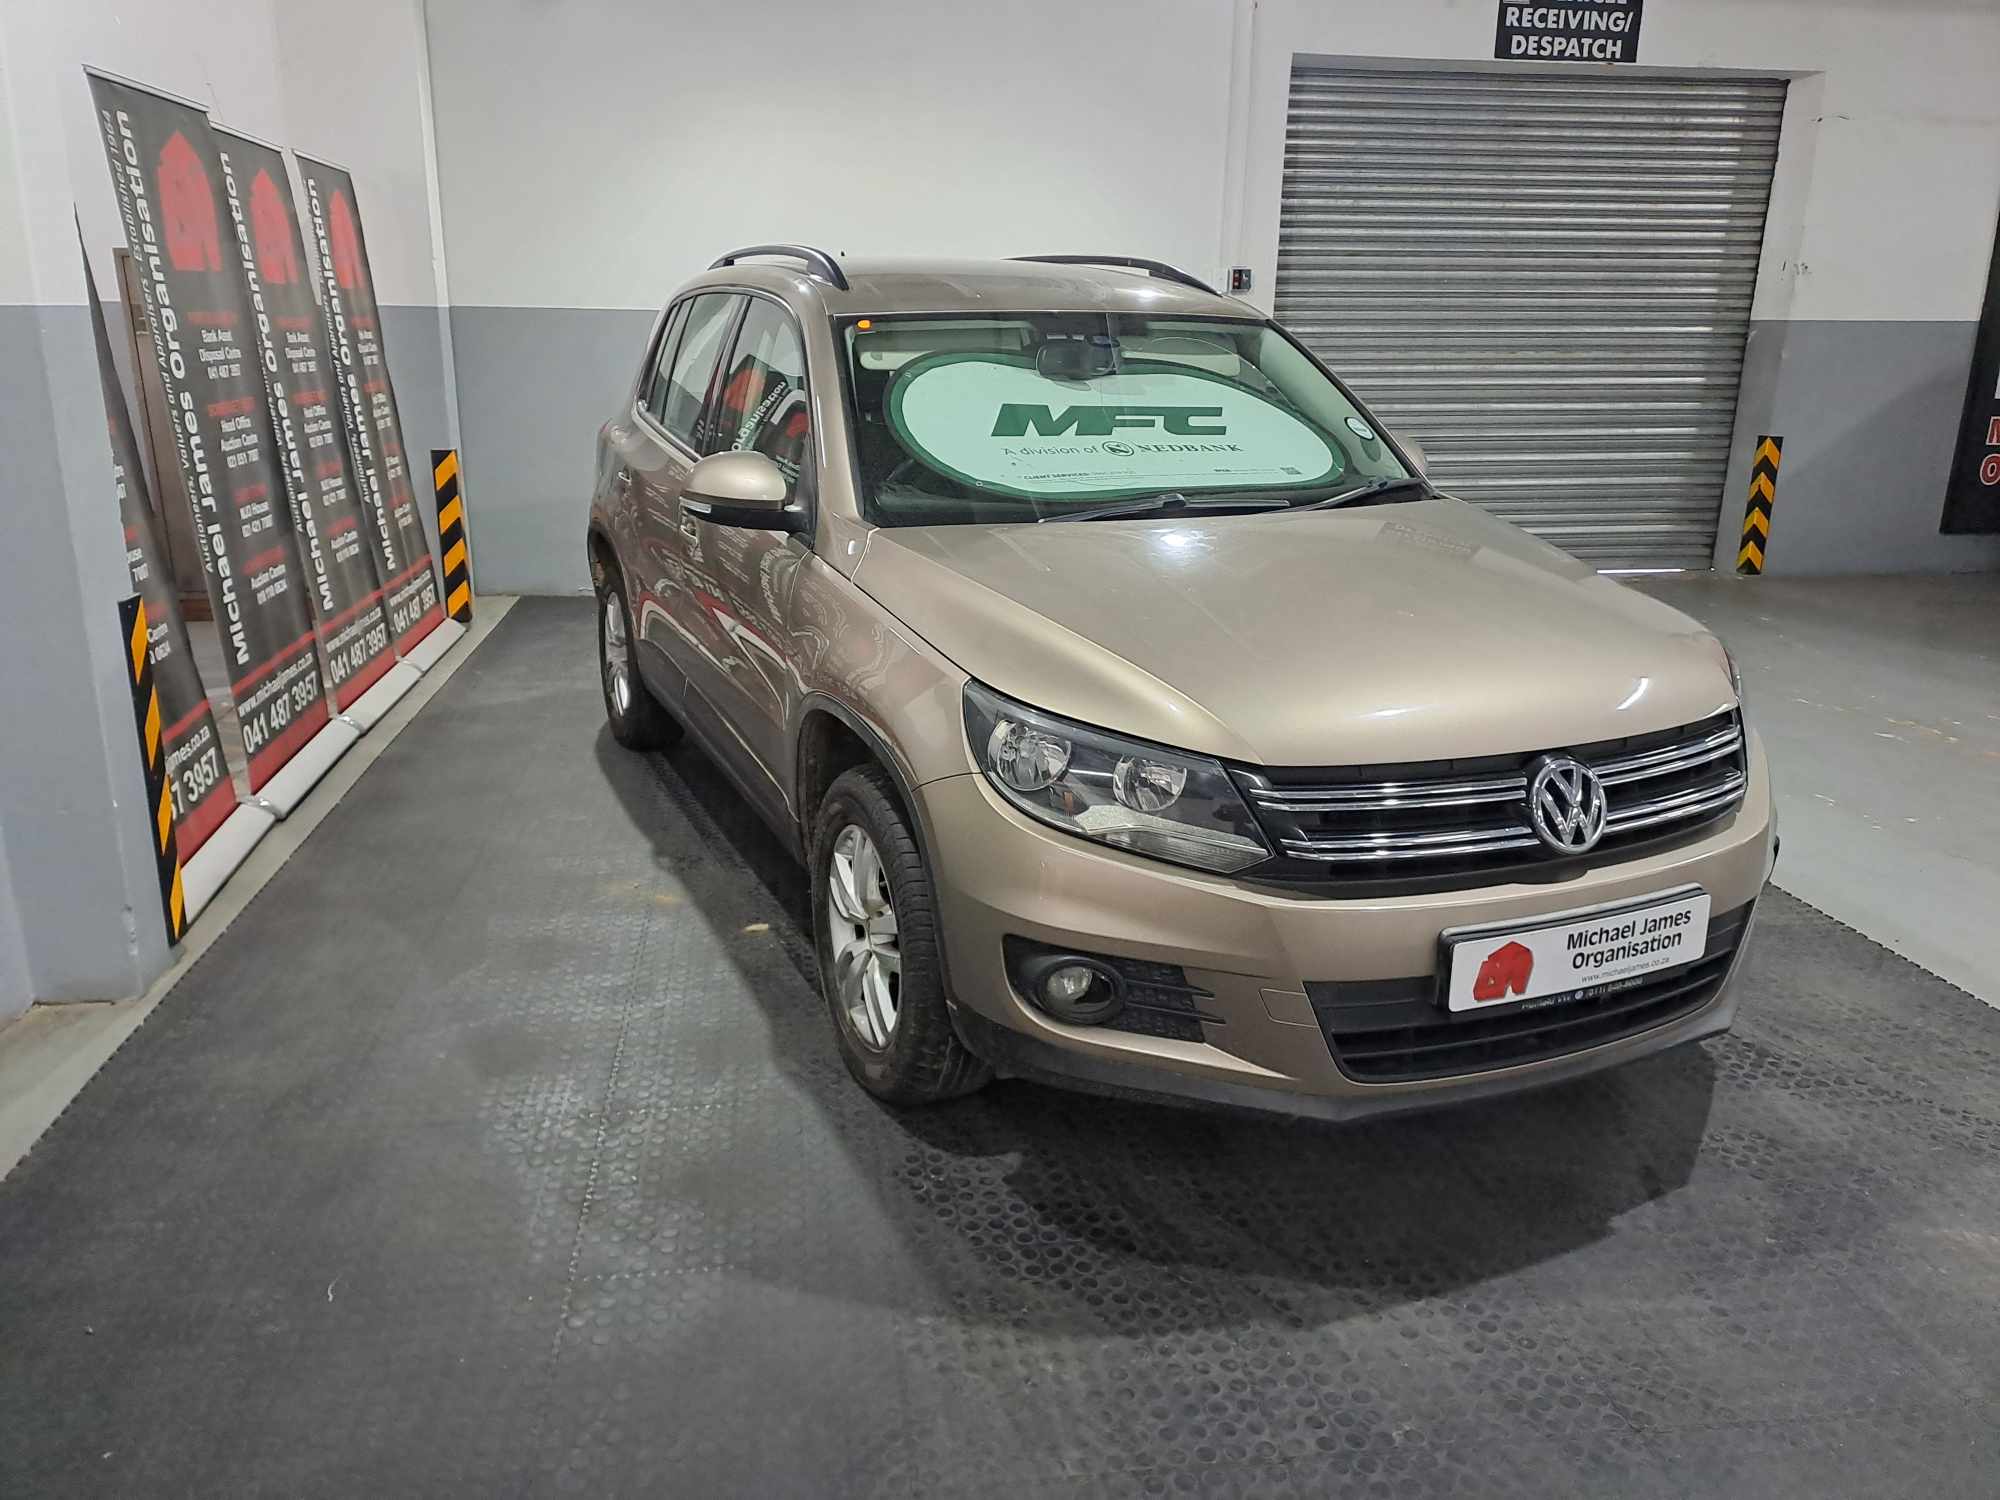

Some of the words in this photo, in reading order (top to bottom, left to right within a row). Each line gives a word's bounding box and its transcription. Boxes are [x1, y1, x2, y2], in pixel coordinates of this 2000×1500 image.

[1505, 7, 1633, 32] RECEIVING/
[1510, 34, 1622, 59] DESPATCH
[102, 109, 119, 154] 1964
[112, 158, 143, 261] Established
[116, 110, 186, 379] Organisation
[219, 152, 277, 373] Organisation
[307, 178, 351, 366] Organisation
[141, 278, 168, 369] Appraisers
[161, 371, 175, 404] and
[347, 373, 372, 461] James
[990, 403, 1227, 437] MFC
[171, 409, 190, 469] Valuers
[180, 391, 217, 513] James
[273, 382, 305, 483] James
[1018, 444, 1081, 456] division
[1083, 443, 1099, 454] of
[1137, 443, 1244, 453] NEDBANK
[297, 491, 334, 611] Michael
[365, 468, 396, 571] Michael
[206, 523, 250, 665] Michael
[330, 651, 351, 684] 041
[350, 639, 367, 668] 487
[366, 622, 387, 655] 3957
[242, 713, 270, 753] 041
[270, 693, 292, 730] 487
[291, 671, 318, 712] 3957
[183, 747, 220, 802] 3957
[1566, 920, 1636, 950] Michael
[1639, 910, 1692, 936] James
[1572, 931, 1682, 969] Organisation
